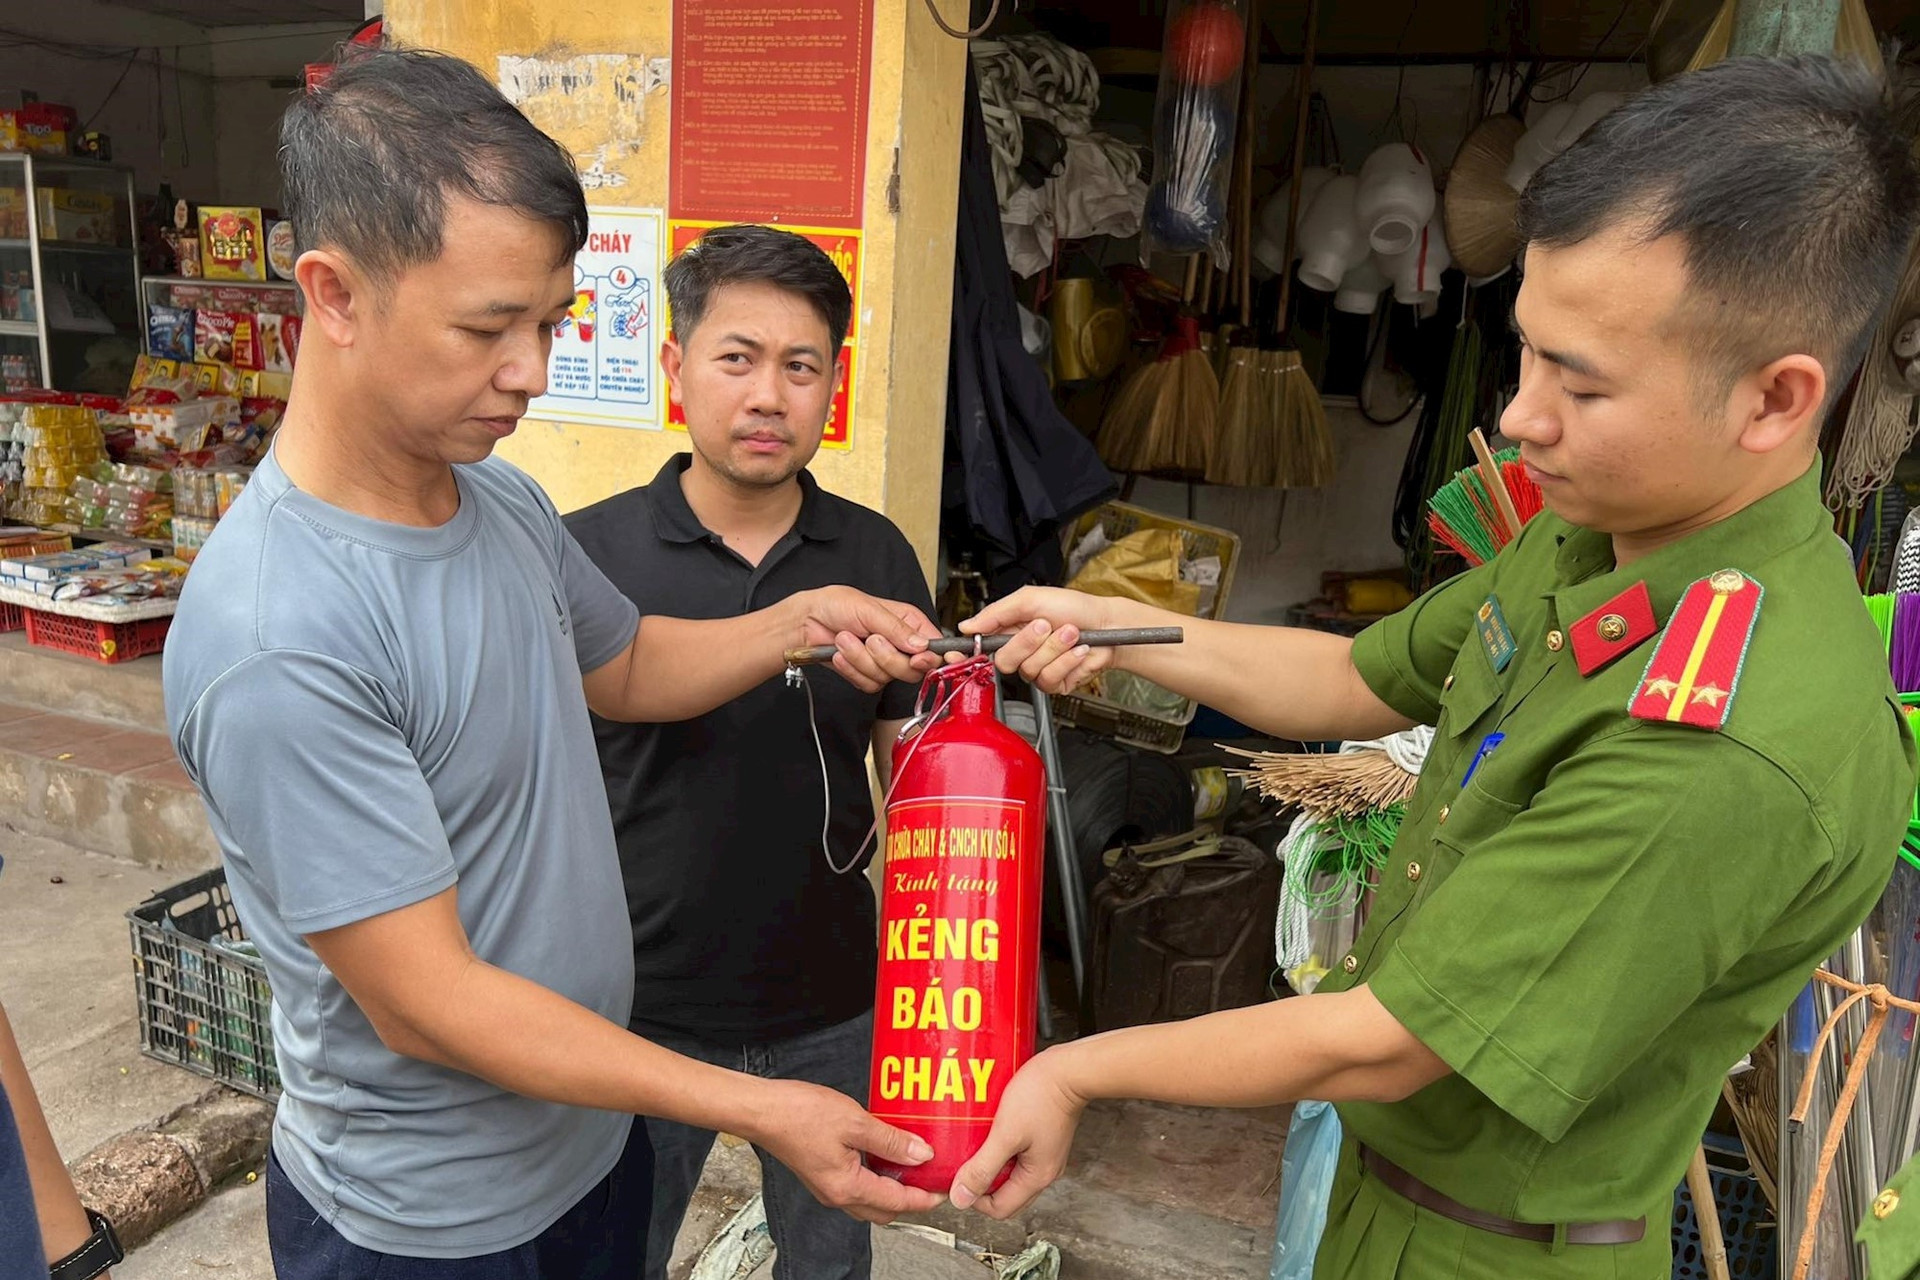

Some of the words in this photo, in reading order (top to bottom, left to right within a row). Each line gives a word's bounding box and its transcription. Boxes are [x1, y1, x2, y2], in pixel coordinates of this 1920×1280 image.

[589, 229, 632, 253] CHÁY
[616, 269, 627, 285] 4
[913, 822, 936, 858] CHÁY
[938, 827, 947, 858] &
[949, 827, 978, 858] CNCH
[980, 828, 994, 859] KV
[995, 820, 1009, 860] SỐ
[1009, 831, 1016, 861] 4
[890, 871, 939, 894] Kính
[946, 873, 998, 897] tặng
[886, 903, 999, 962] KẺNG
[892, 977, 982, 1031] BÁO
[880, 1047, 996, 1102] CHÁY
